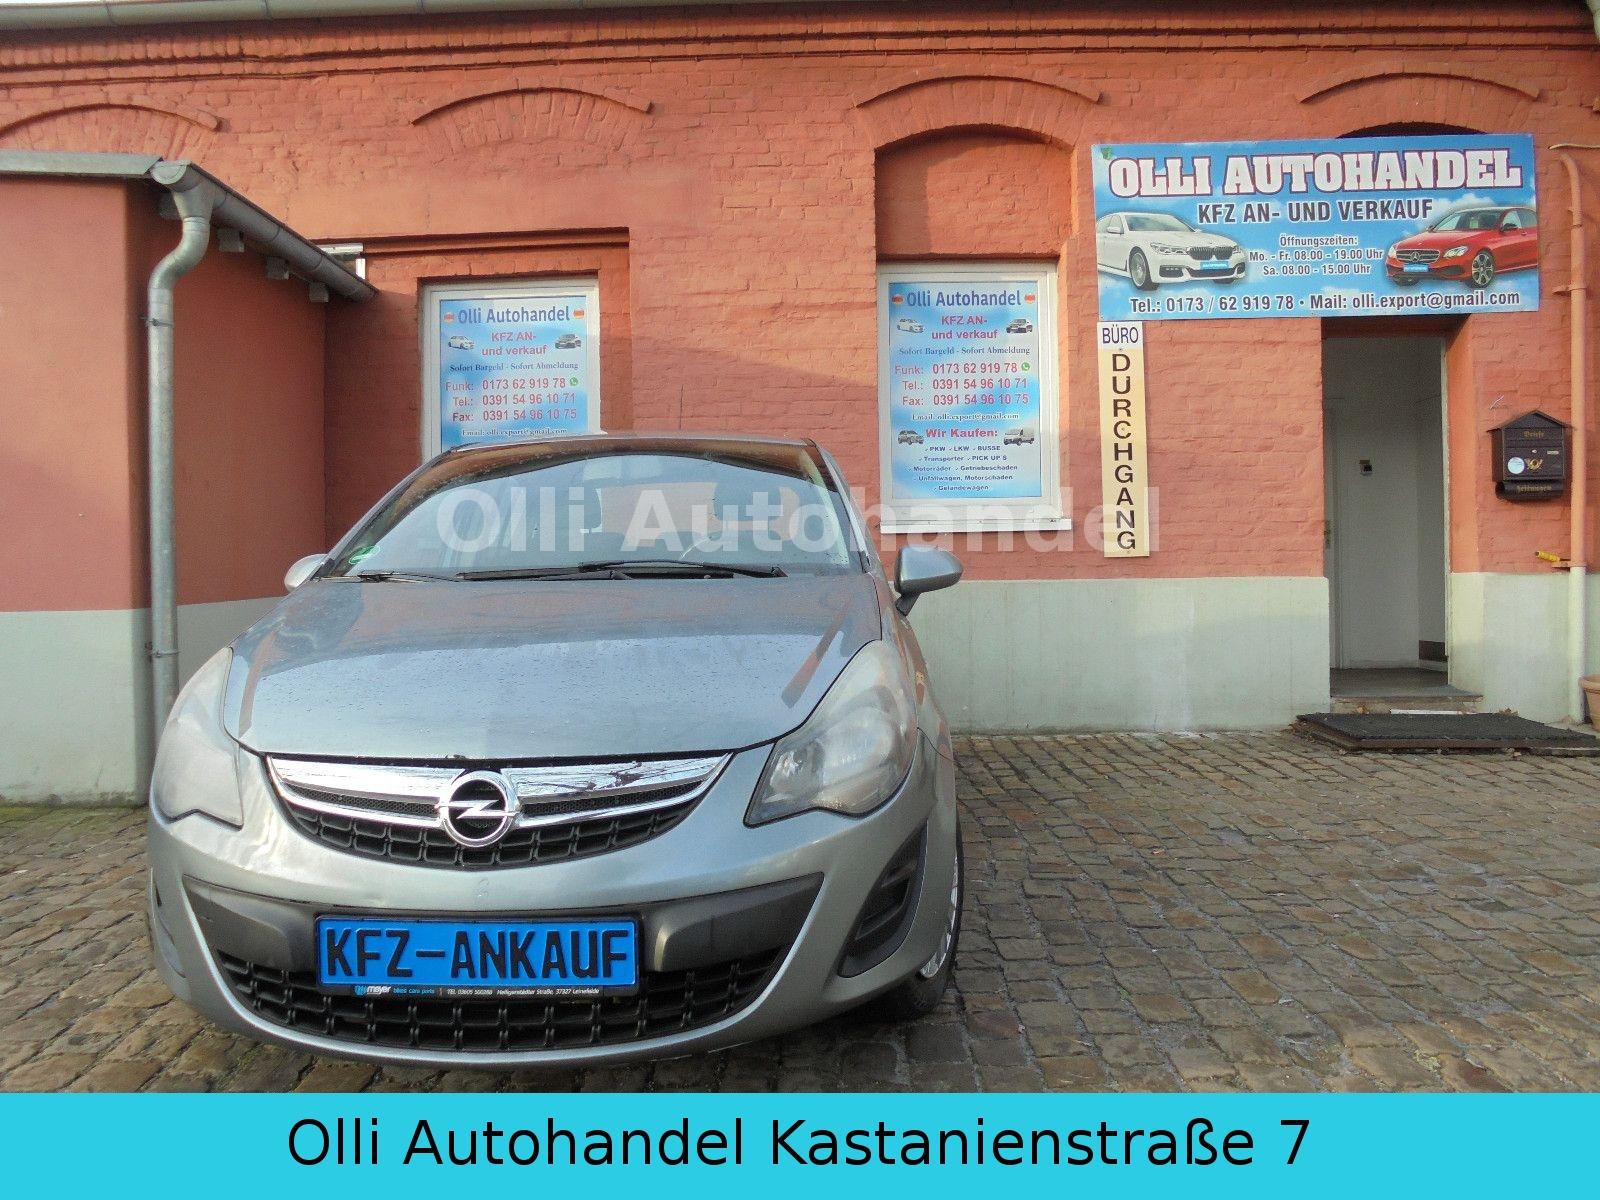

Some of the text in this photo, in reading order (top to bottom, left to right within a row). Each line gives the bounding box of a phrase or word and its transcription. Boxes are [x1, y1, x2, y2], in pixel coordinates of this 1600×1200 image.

[1109, 148, 1522, 198] OLLI AUTOHANDEL
[1198, 199, 1434, 224] KFZ AN- UND VERKAUF
[1279, 234, 1358, 249] Öffnungszeiten:
[1249, 250, 1269, 261] Mo.
[1280, 250, 1293, 260] Fr.
[1295, 249, 1323, 260] 08.00
[1335, 249, 1362, 259] 19.00
[1366, 249, 1383, 259] Uhr
[1263, 265, 1280, 275] Sa.
[1282, 264, 1309, 275] 08.00
[1322, 264, 1349, 274] 15.00
[1353, 264, 1371, 274] Uhr
[907, 290, 1021, 306] Olli Autohandel
[1131, 298, 1161, 313] Tel.:
[1166, 297, 1204, 311] 0173
[1219, 297, 1237, 310] 62
[1242, 296, 1270, 310] 919
[1275, 295, 1294, 309] 78
[1310, 294, 1348, 309] Mail:
[1352, 291, 1519, 310] olli.export@gmail.com
[458, 306, 570, 324] Olli Autohandel
[941, 316, 988, 324] KFZ AN-
[491, 332, 536, 342] KFZ AN-
[932, 330, 998, 339] und verkauf
[1102, 324, 1139, 344] BÜRO
[482, 346, 548, 356] und verkauf
[895, 363, 1018, 375] Funk: 0173 62 919 78
[482, 379, 508, 390] 0173
[512, 379, 525, 389] 62
[529, 379, 549, 388] 919
[553, 378, 566, 388] 78
[932, 379, 959, 389] 0391
[963, 379, 977, 389] 54
[980, 379, 994, 388] 96
[998, 378, 1010, 388] 10
[1015, 378, 1027, 388] 71
[482, 395, 508, 406] 0391
[512, 395, 525, 405] 54
[529, 394, 542, 404] 96
[546, 394, 559, 403] 10
[563, 393, 576, 403] 71
[902, 394, 1028, 405] Fax: 0391 54 96 10 75
[452, 409, 577, 422] Fax: 0391 54 96 10 75
[926, 429, 998, 438] Wir Kaufen:
[1112, 353, 1135, 550] DURCHGANG
[326, 928, 629, 978] KFZ-ANKAUF
